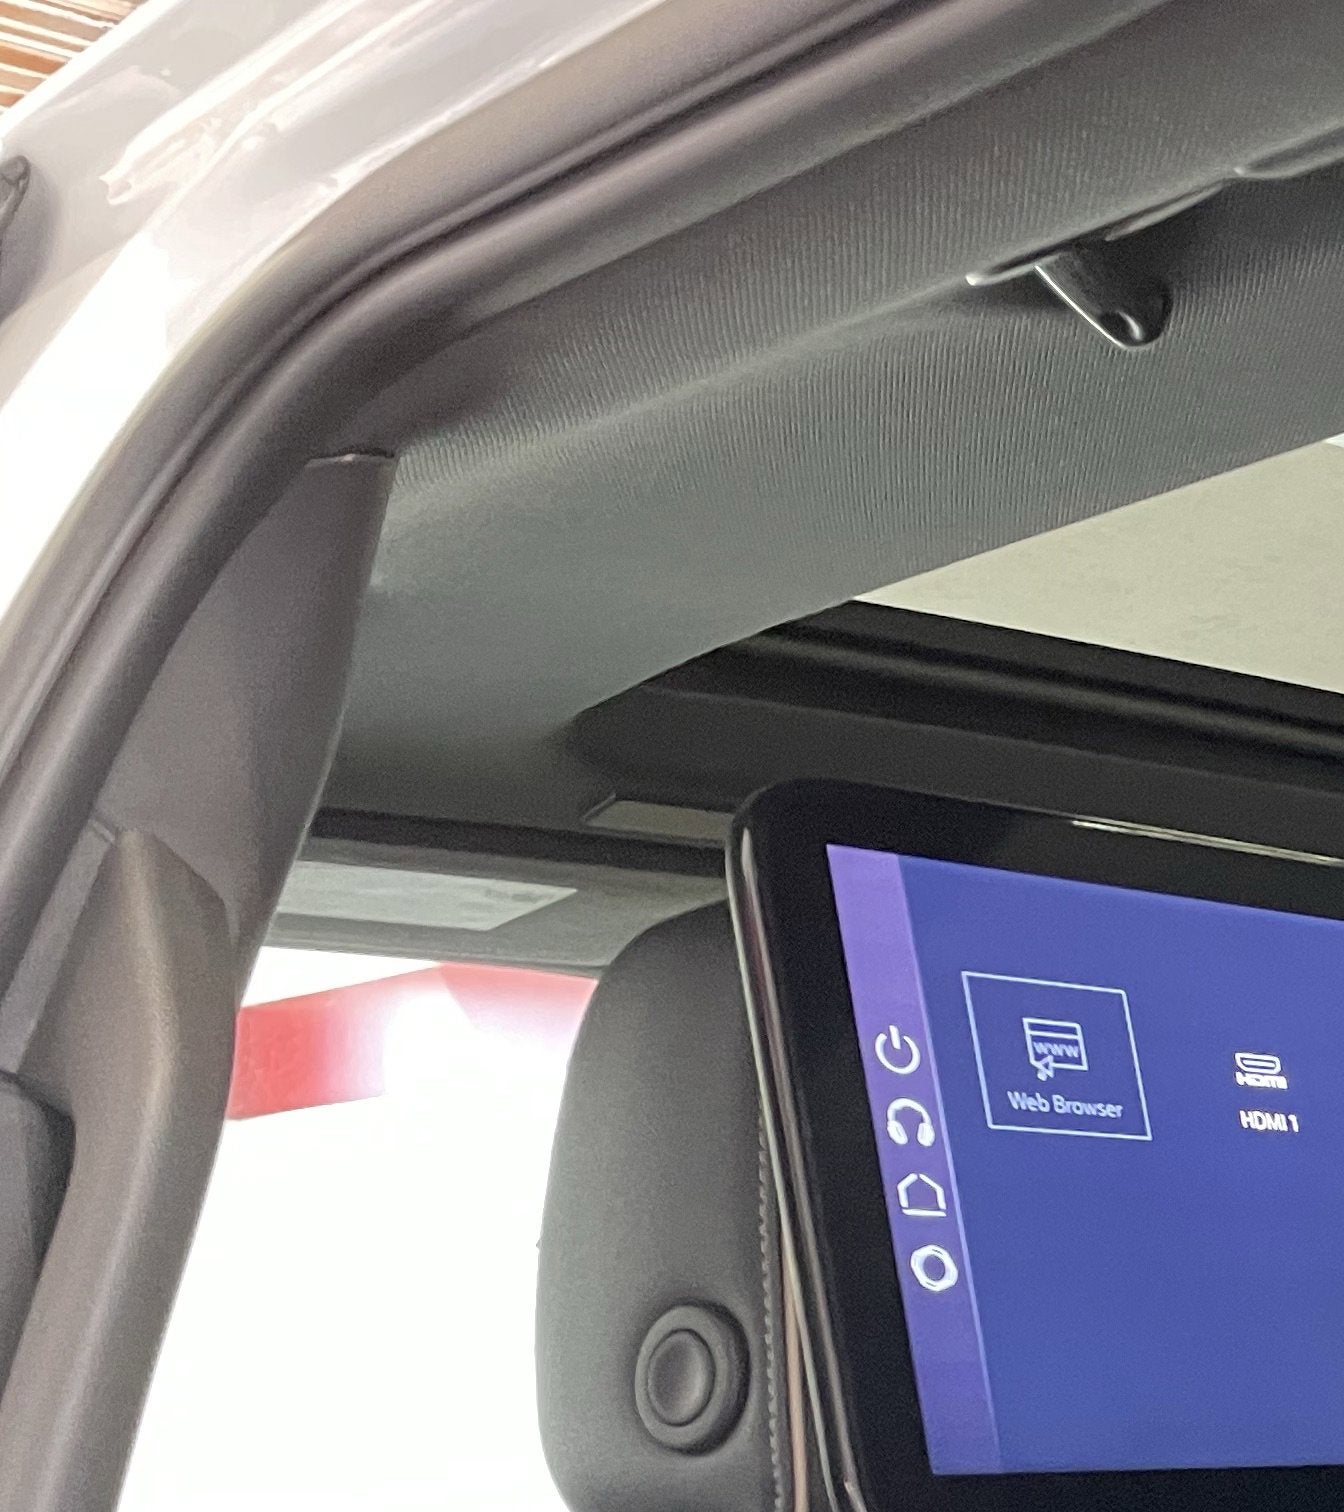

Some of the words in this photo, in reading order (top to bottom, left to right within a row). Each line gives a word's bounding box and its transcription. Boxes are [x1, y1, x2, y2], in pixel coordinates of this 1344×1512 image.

[1008, 1091, 1050, 1113] Web
[1054, 1095, 1123, 1119] Browser
[1240, 1110, 1288, 1132] HDMI
[1289, 1115, 1301, 1133] 1
